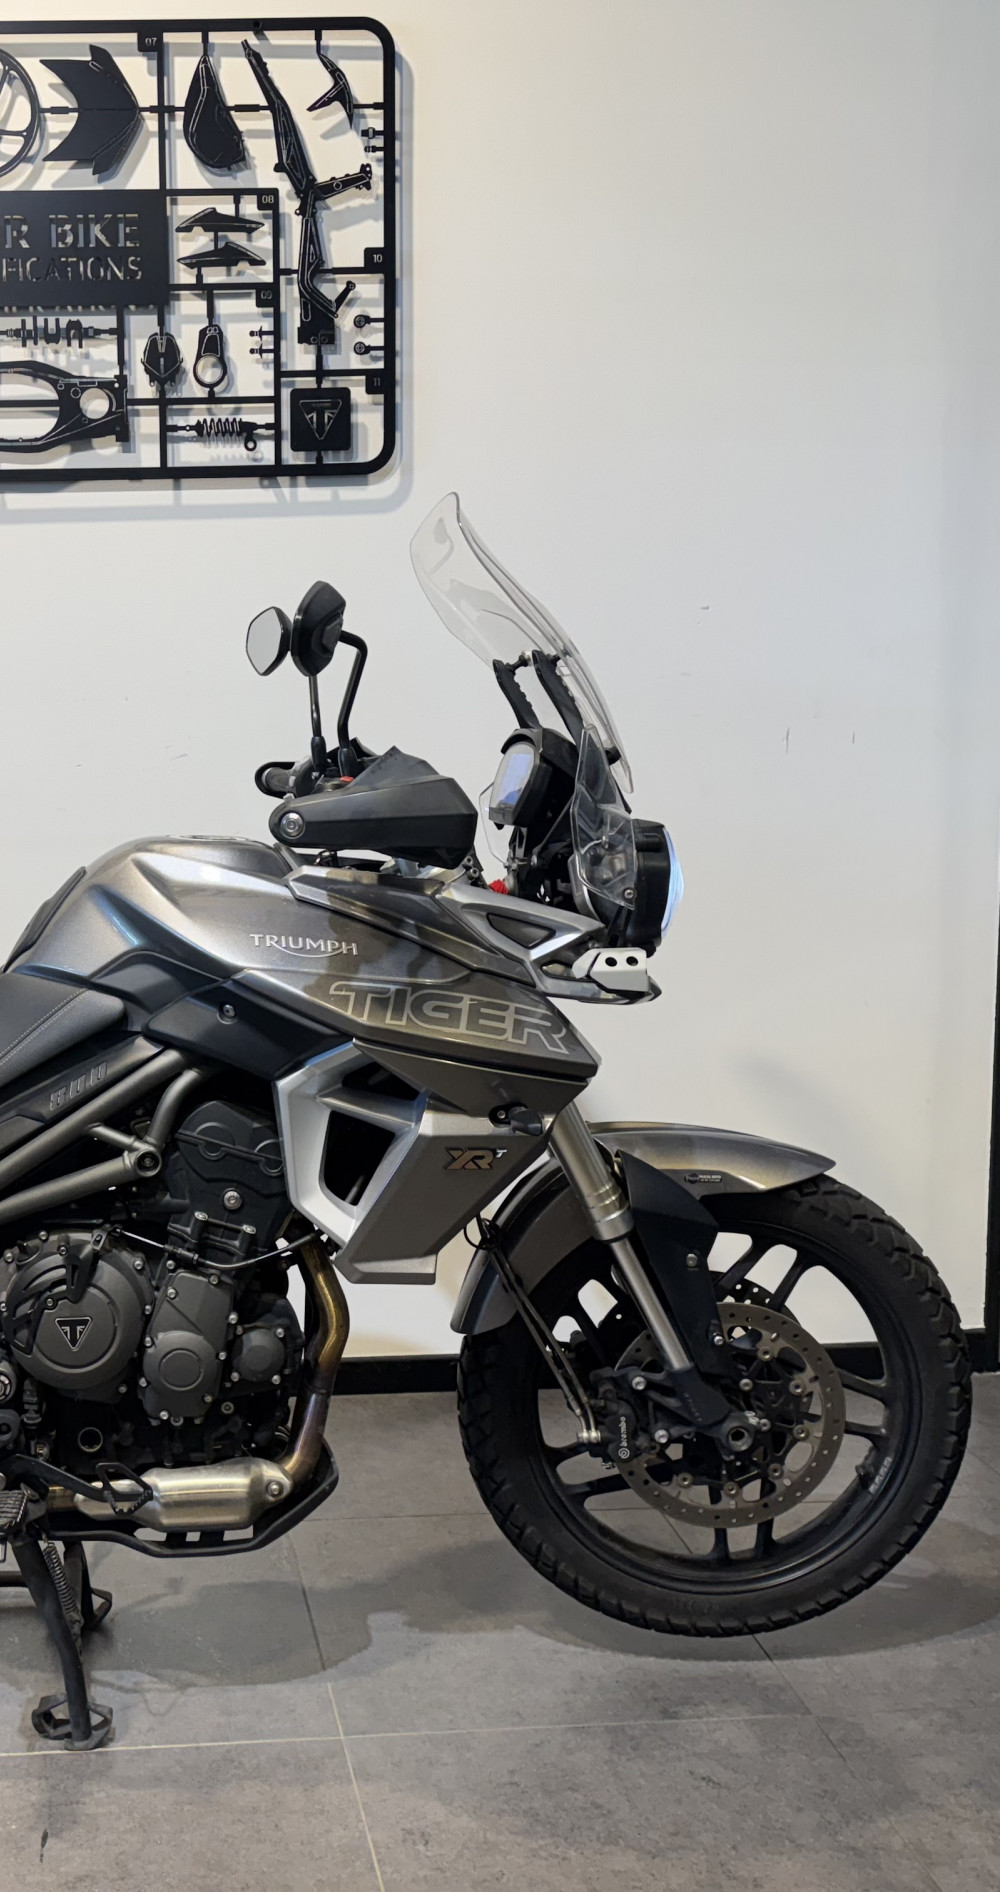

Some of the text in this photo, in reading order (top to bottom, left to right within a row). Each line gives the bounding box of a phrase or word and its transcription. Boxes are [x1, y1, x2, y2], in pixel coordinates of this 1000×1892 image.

[145, 37, 157, 46] 07
[261, 195, 274, 204] 08
[49, 213, 140, 249] BIKE
[372, 254, 383, 263] 10
[260, 290, 273, 300] 09
[373, 377, 381, 387] 11
[249, 933, 359, 957] TRIUMPH
[329, 980, 570, 1055] TIGER
[619, 1416, 628, 1447] brembo
